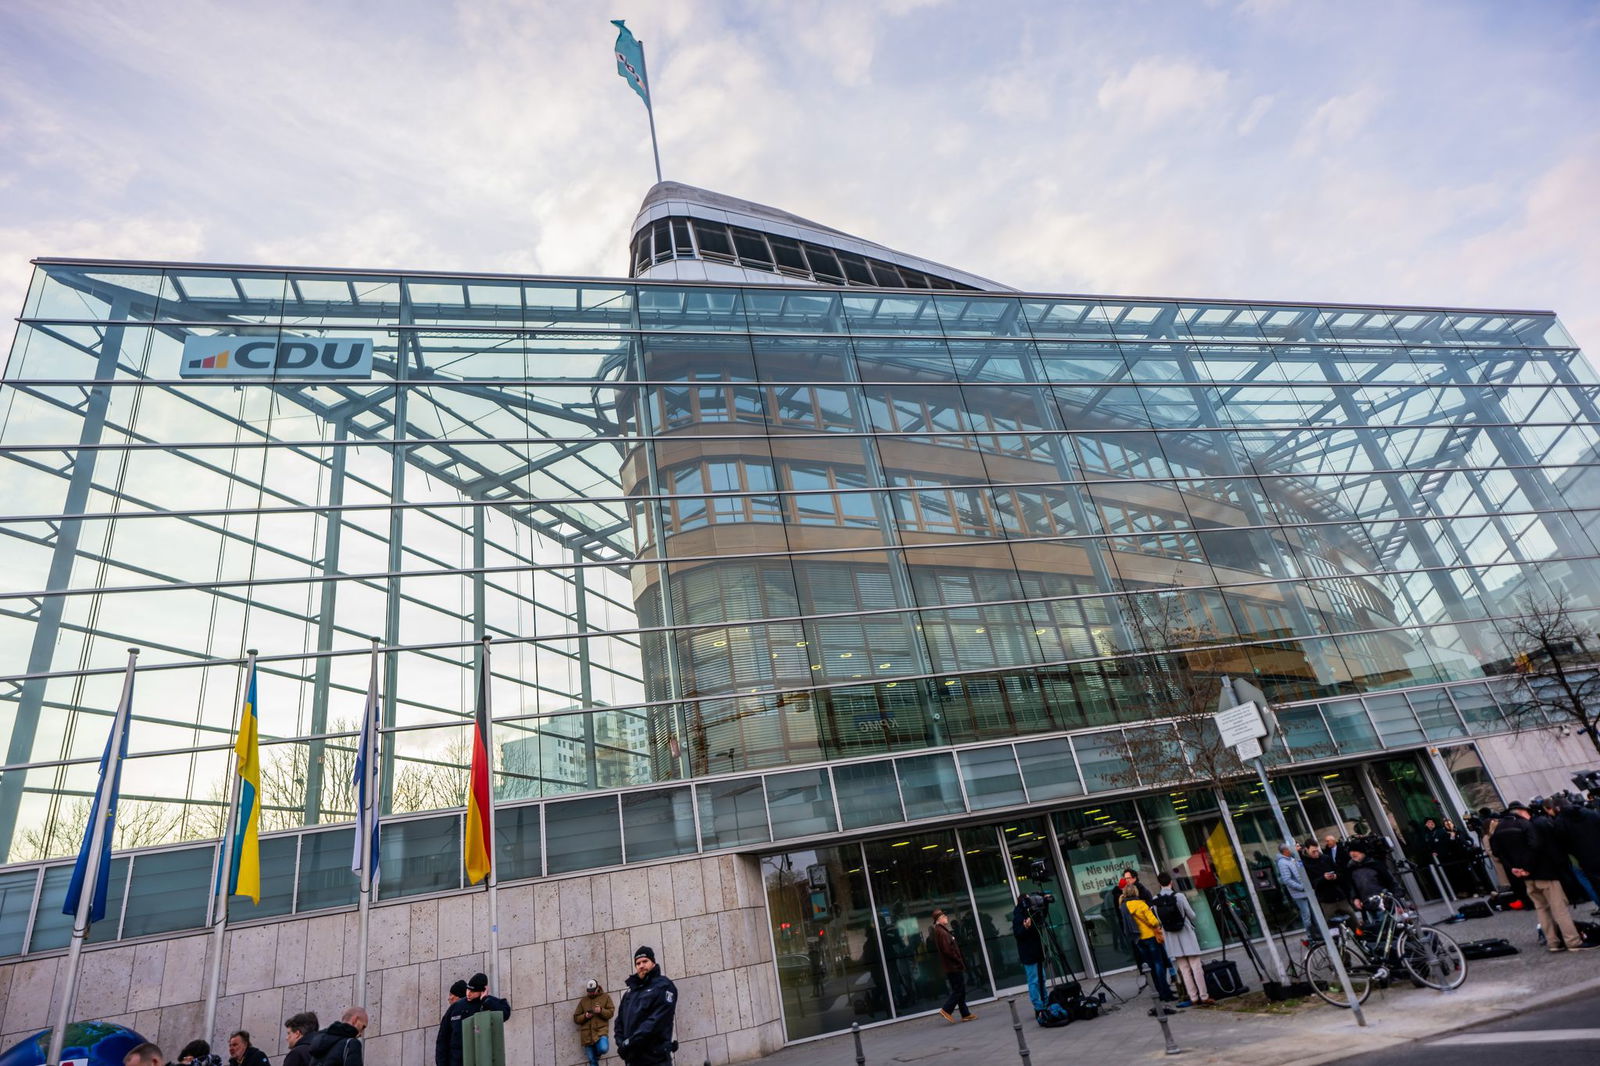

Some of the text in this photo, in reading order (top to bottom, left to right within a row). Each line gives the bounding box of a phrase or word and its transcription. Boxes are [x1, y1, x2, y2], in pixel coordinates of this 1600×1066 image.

[234, 341, 365, 370] CDU
[1086, 861, 1134, 876] Nie wieder
[1081, 879, 1095, 890] ist
